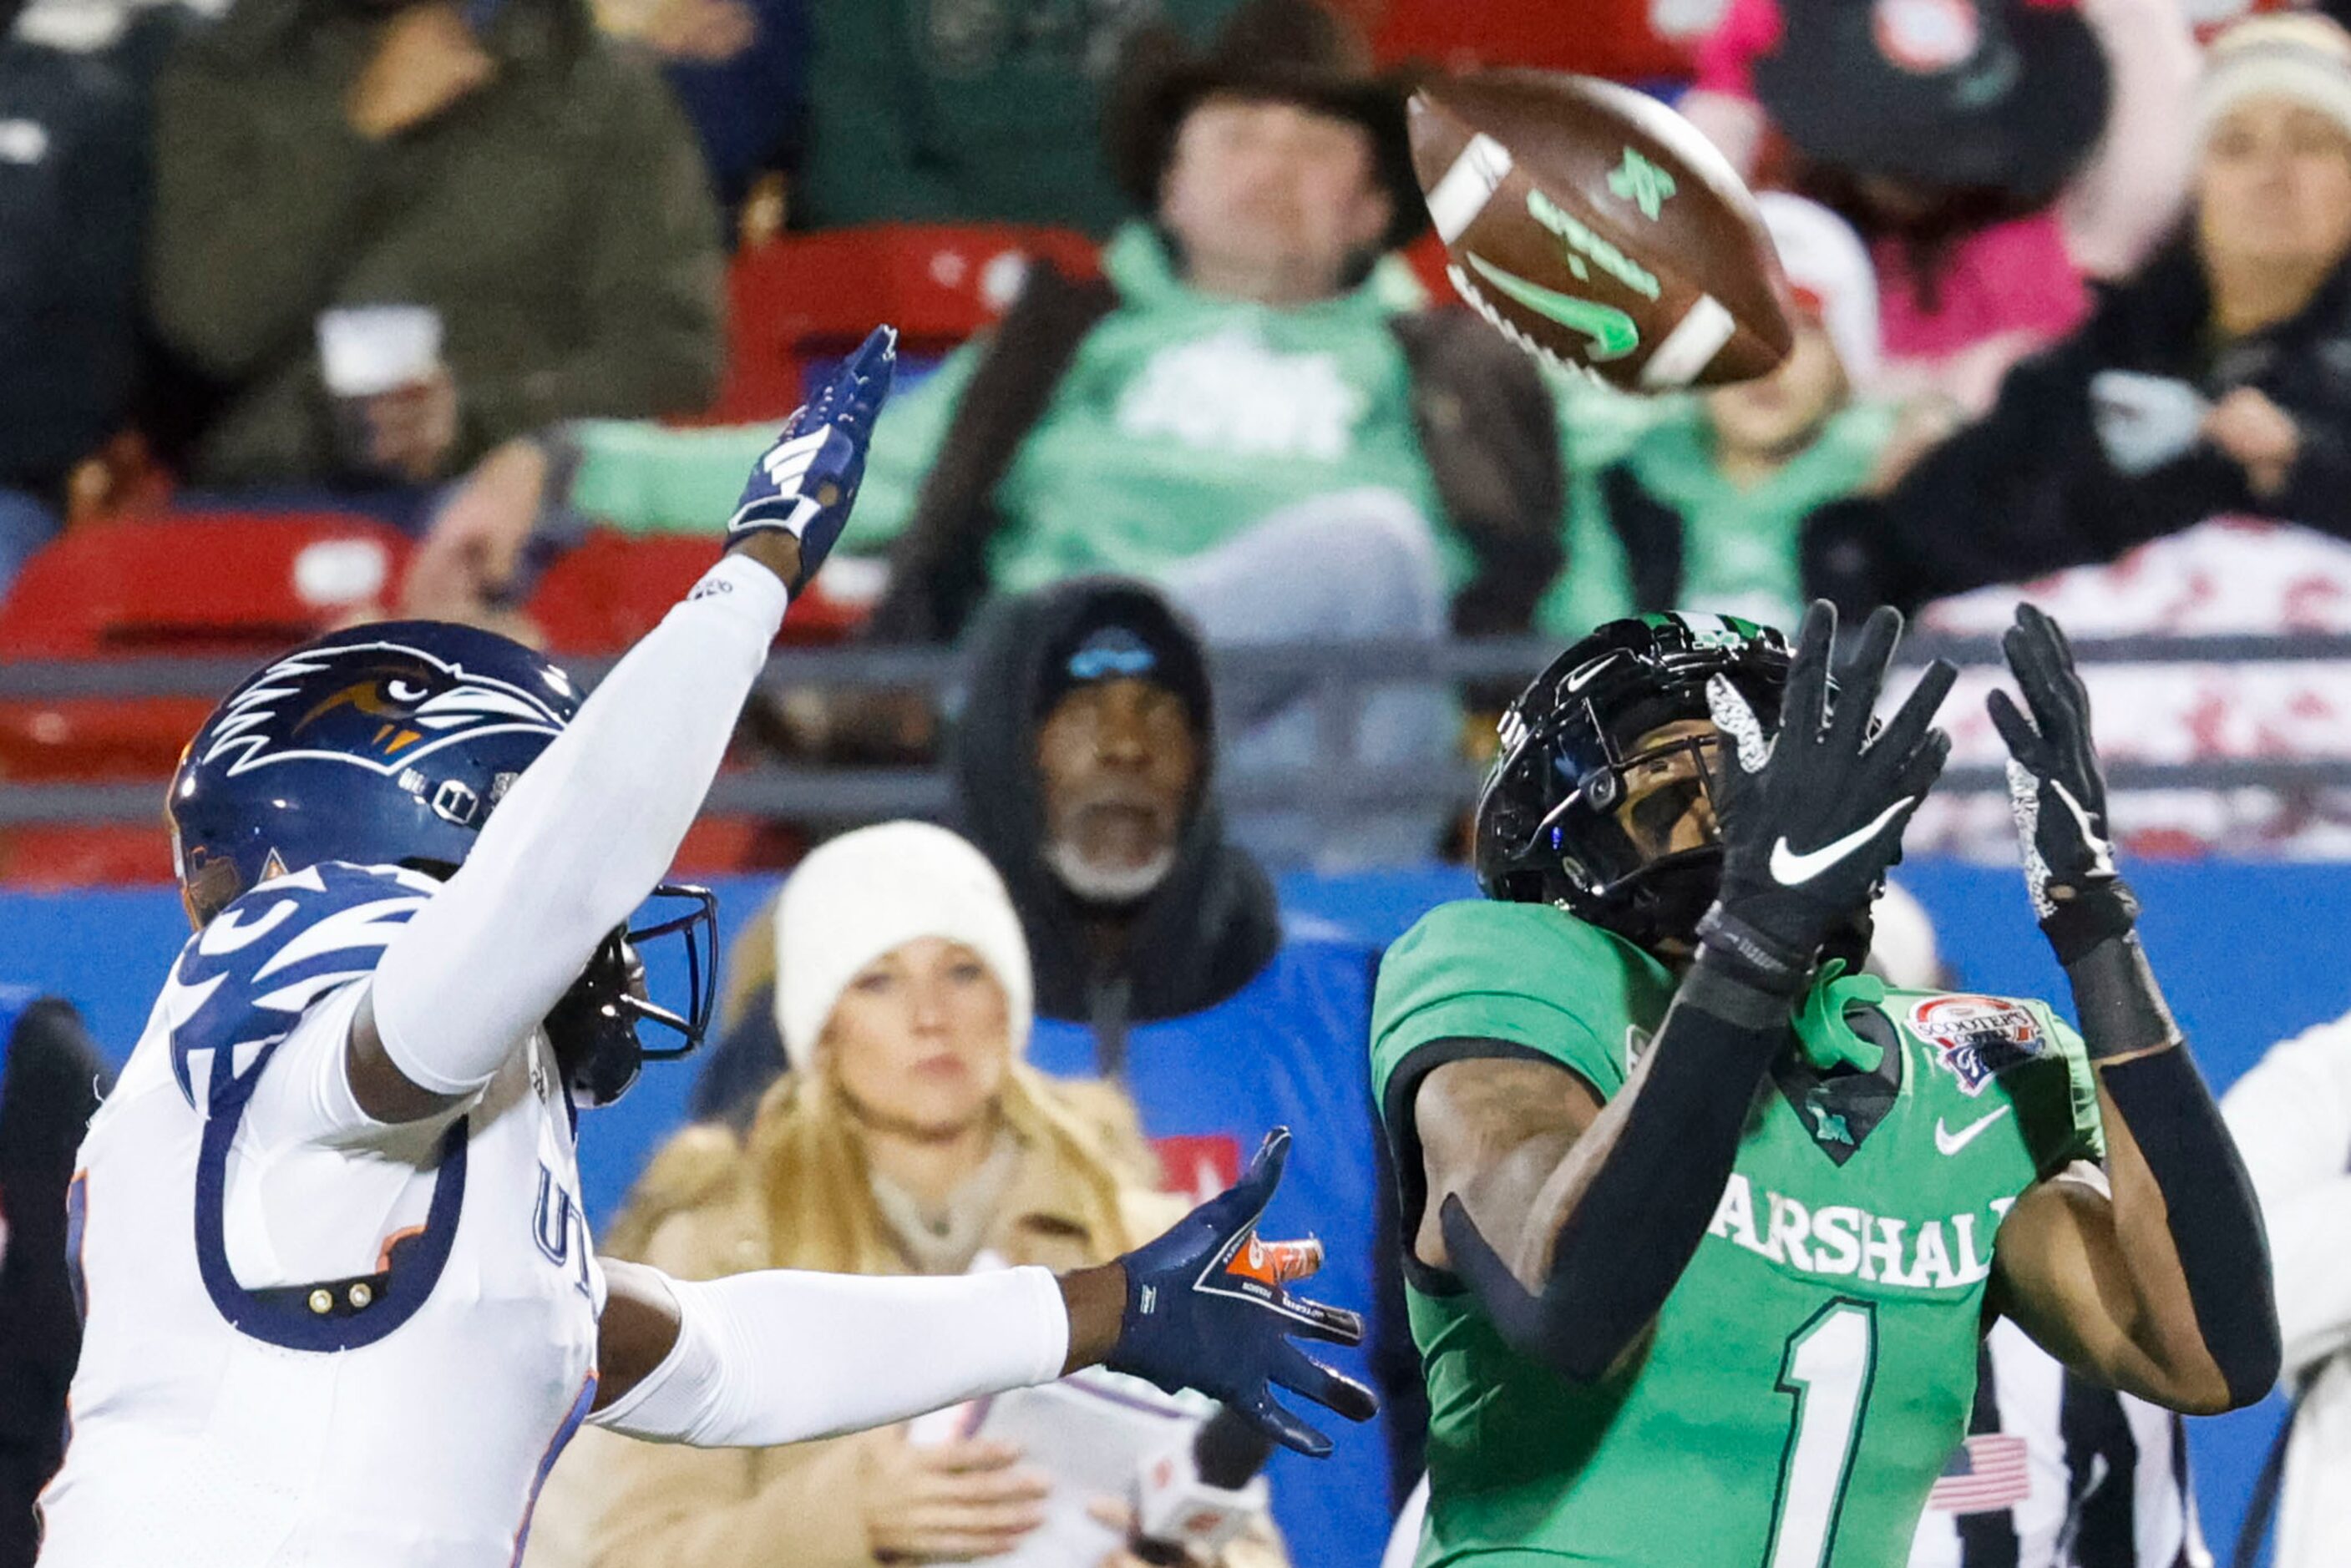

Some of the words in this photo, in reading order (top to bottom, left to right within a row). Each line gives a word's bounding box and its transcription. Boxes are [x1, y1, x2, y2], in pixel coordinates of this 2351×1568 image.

[1918, 1012, 2028, 1035] SCOOTER'S
[1708, 1173, 2016, 1288] ARSHAL
[1759, 1296, 1877, 1568] 1
